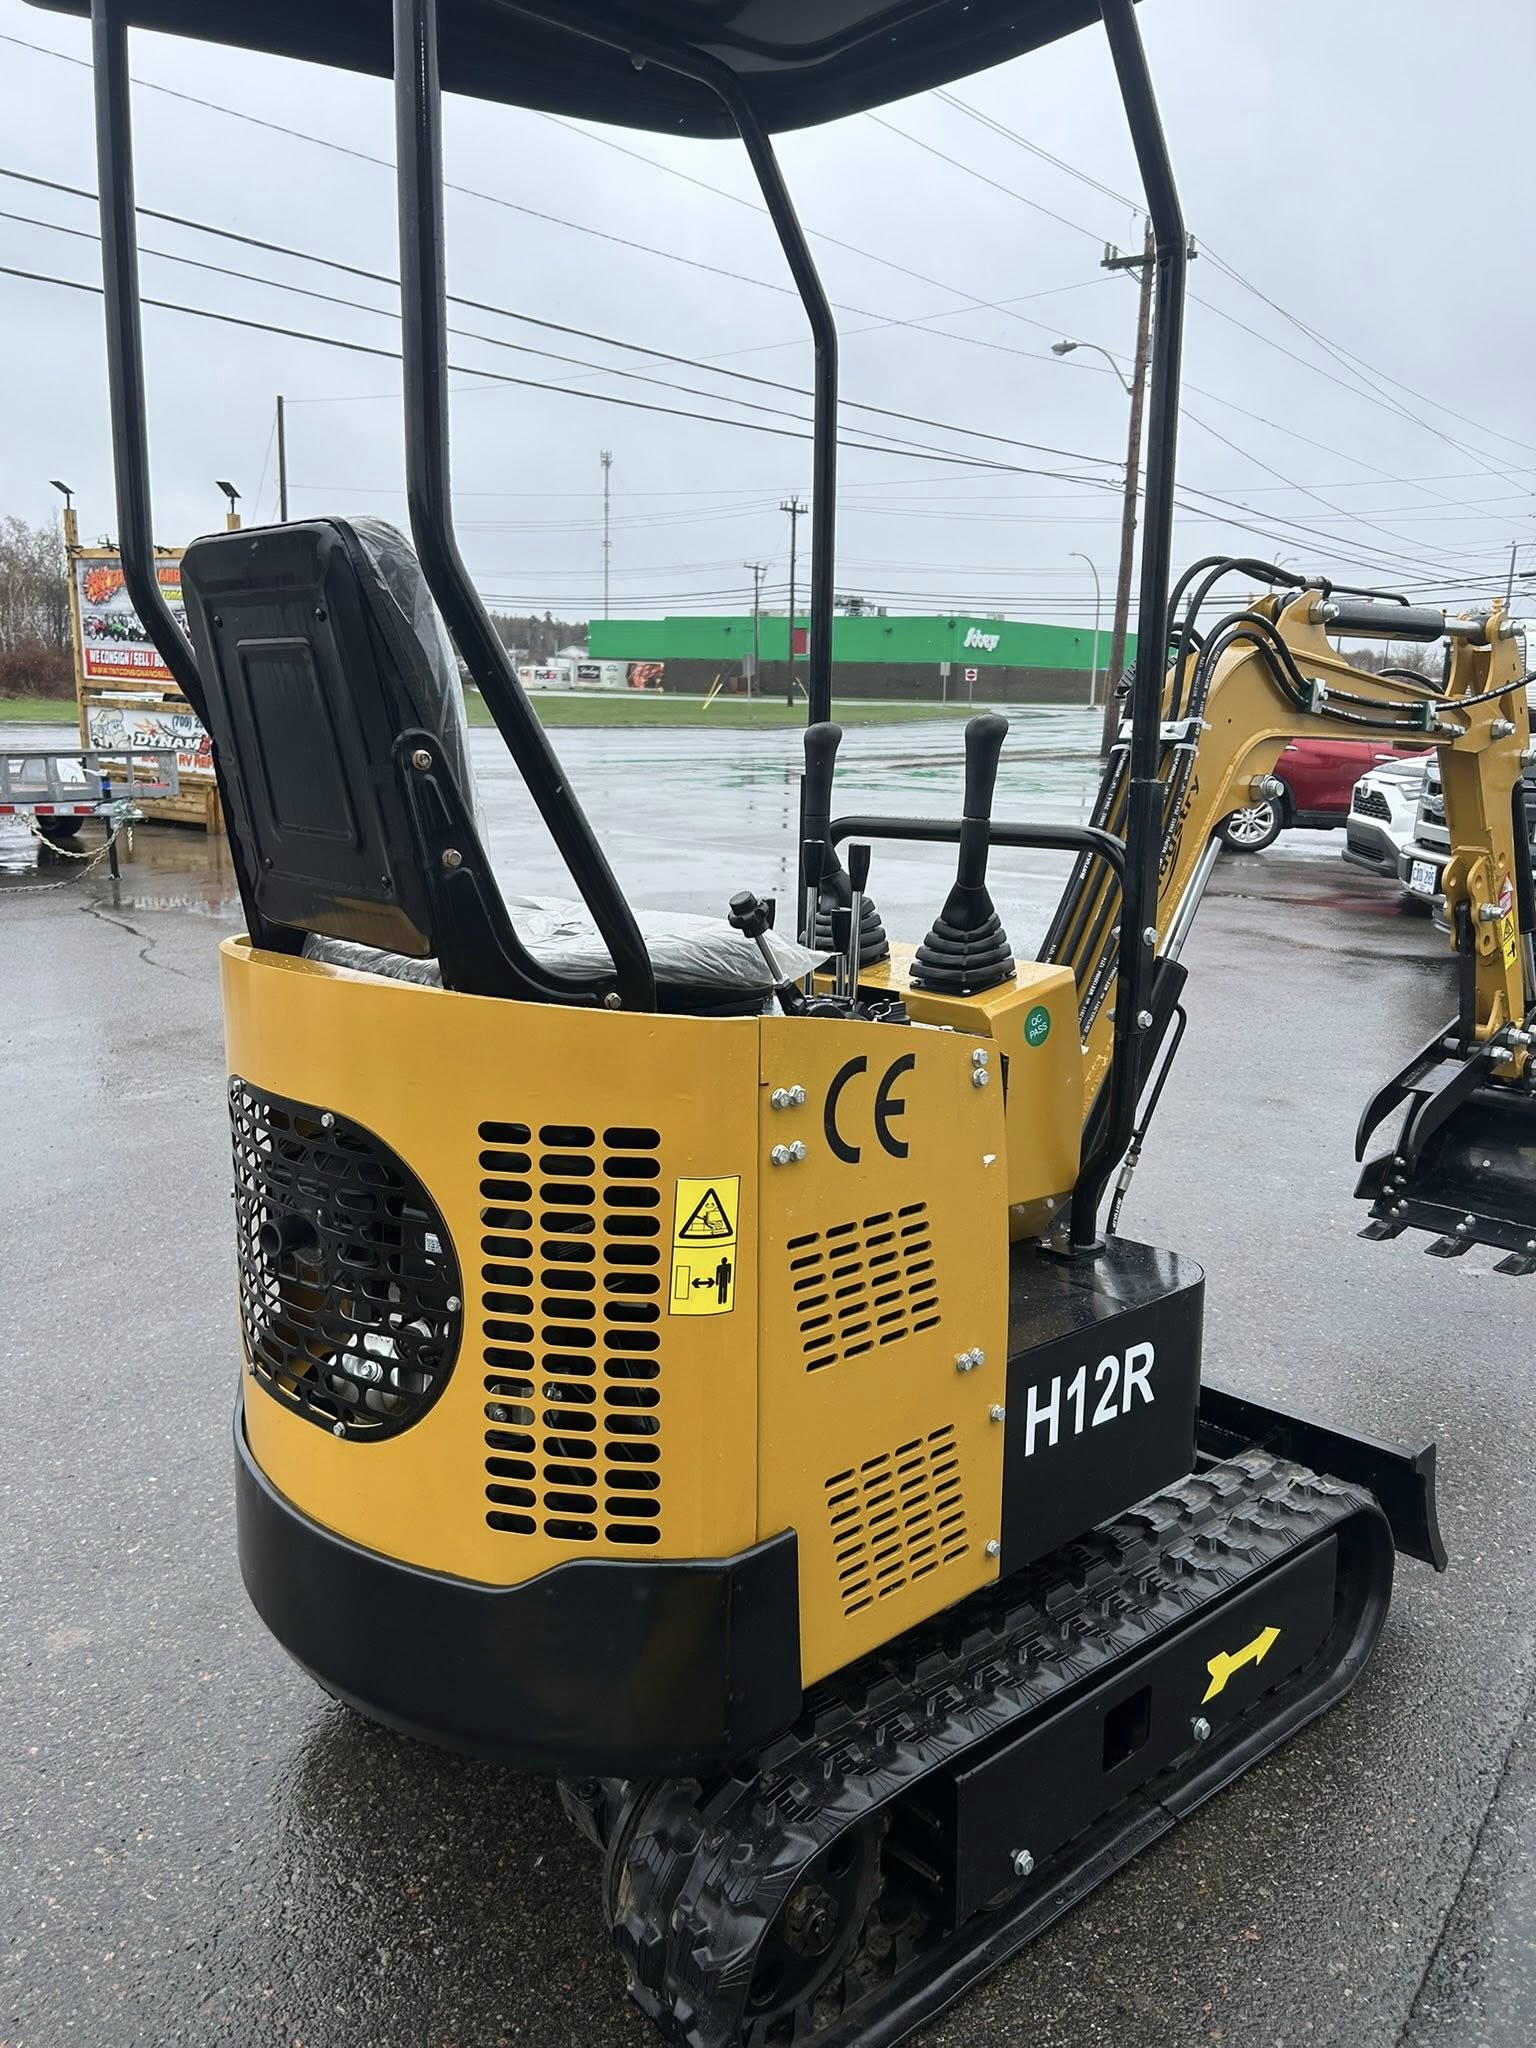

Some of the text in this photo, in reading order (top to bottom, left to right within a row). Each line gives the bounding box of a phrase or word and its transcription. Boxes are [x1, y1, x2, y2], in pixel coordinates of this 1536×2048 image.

[89, 649, 100, 664] WE
[100, 650, 129, 666] CONSIGN
[134, 652, 150, 667] SELL
[534, 669, 558, 681] FedEx
[172, 715, 192, 731] (709)
[133, 732, 203, 753] DYNAM
[178, 754, 213, 768] RV REP
[1031, 1013, 1043, 1027] QC
[1029, 1021, 1048, 1040] PASS
[823, 1052, 916, 1164] CE
[1024, 1341, 1156, 1458] H12R
